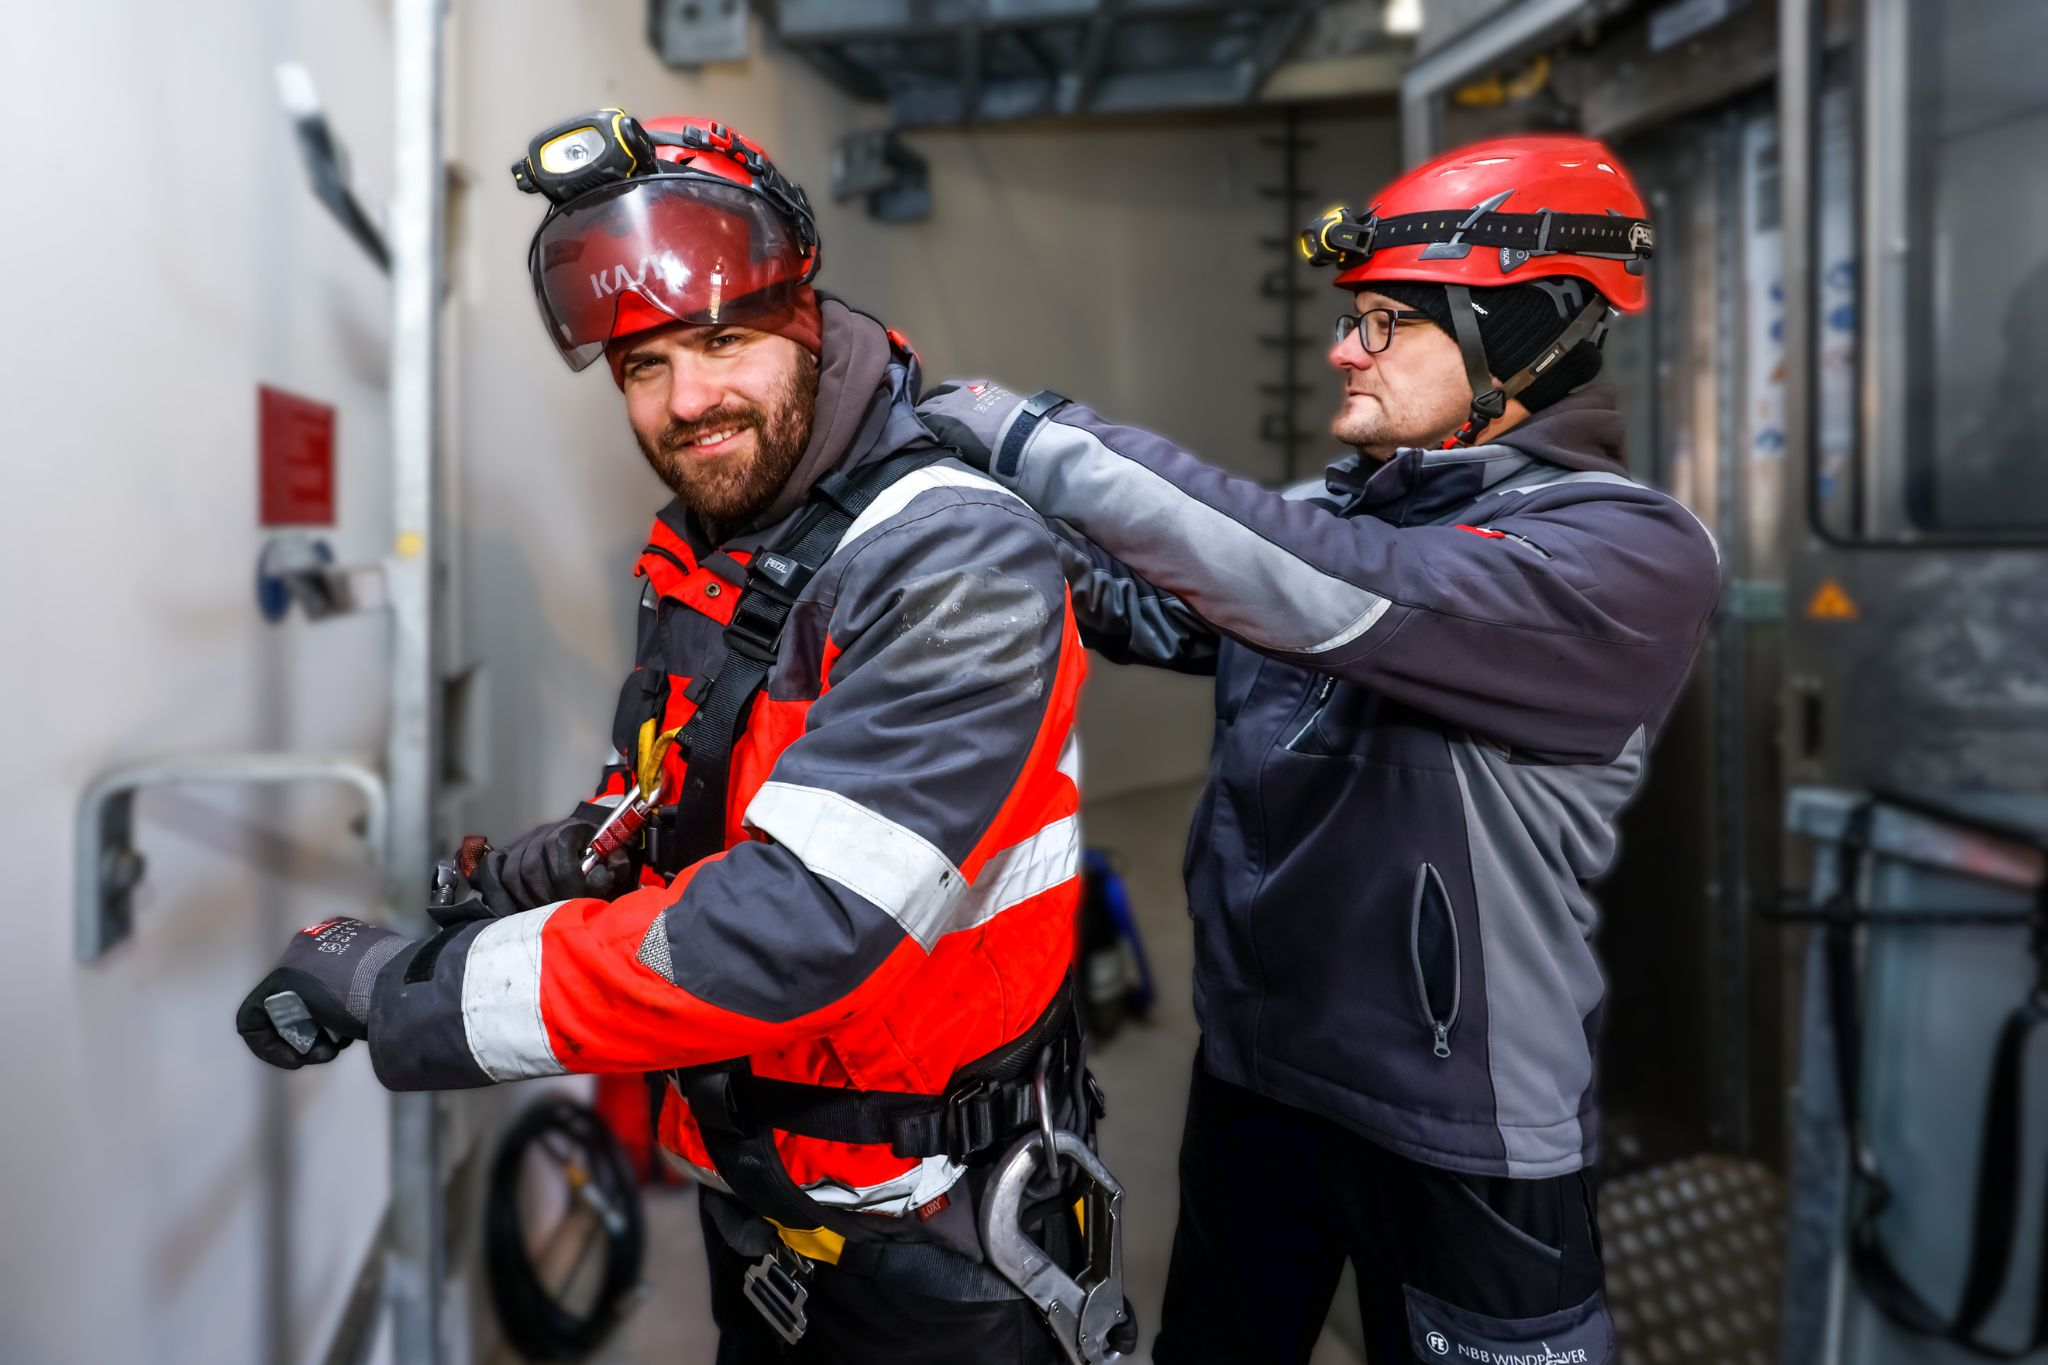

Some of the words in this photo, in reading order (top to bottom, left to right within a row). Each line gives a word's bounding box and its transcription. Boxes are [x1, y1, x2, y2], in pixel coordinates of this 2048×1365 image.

[764, 557, 787, 574] PETZL
[1430, 1336, 1445, 1352] FE
[1457, 1343, 1490, 1364] NBB
